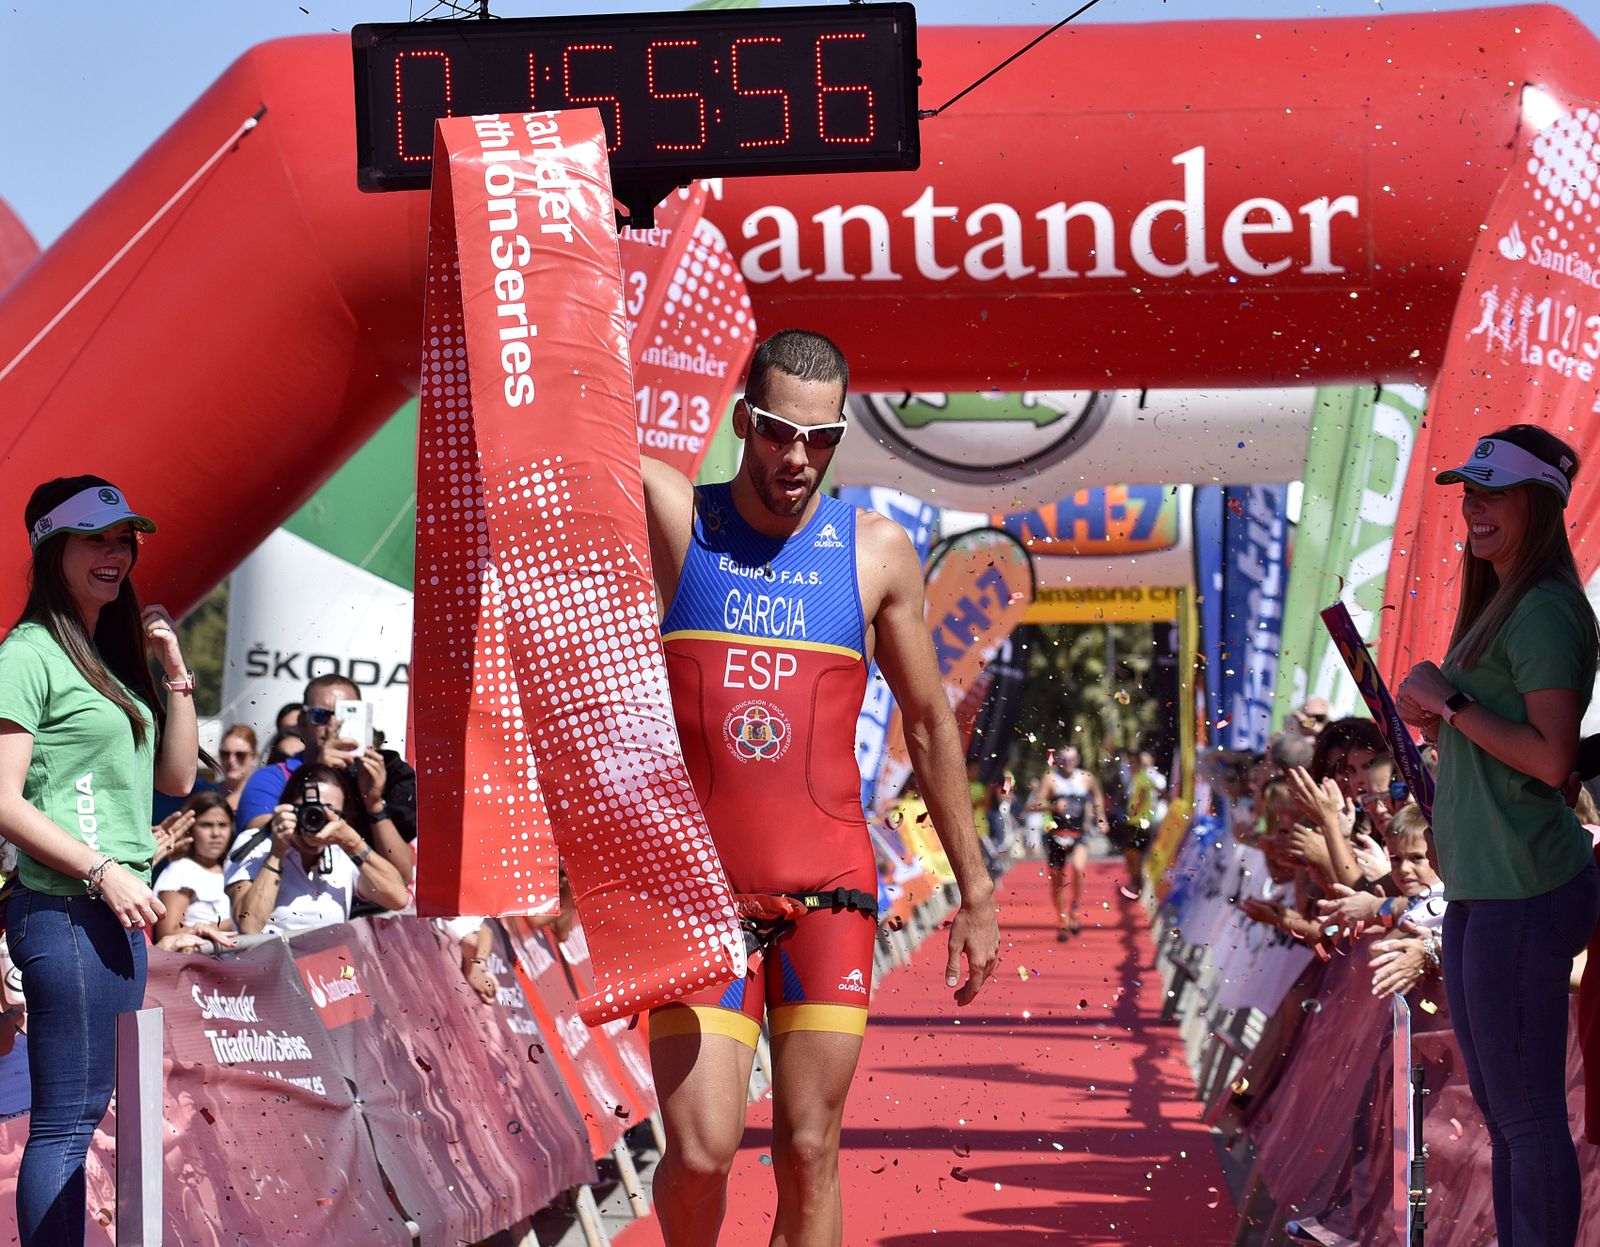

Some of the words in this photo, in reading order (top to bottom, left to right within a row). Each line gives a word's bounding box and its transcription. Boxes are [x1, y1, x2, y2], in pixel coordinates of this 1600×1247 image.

[697, 147, 1358, 283] antander
[719, 556, 776, 582] EQUIPO
[781, 571, 822, 585] F.A.S.
[724, 588, 806, 638] GARCIA
[723, 648, 797, 691] ESP
